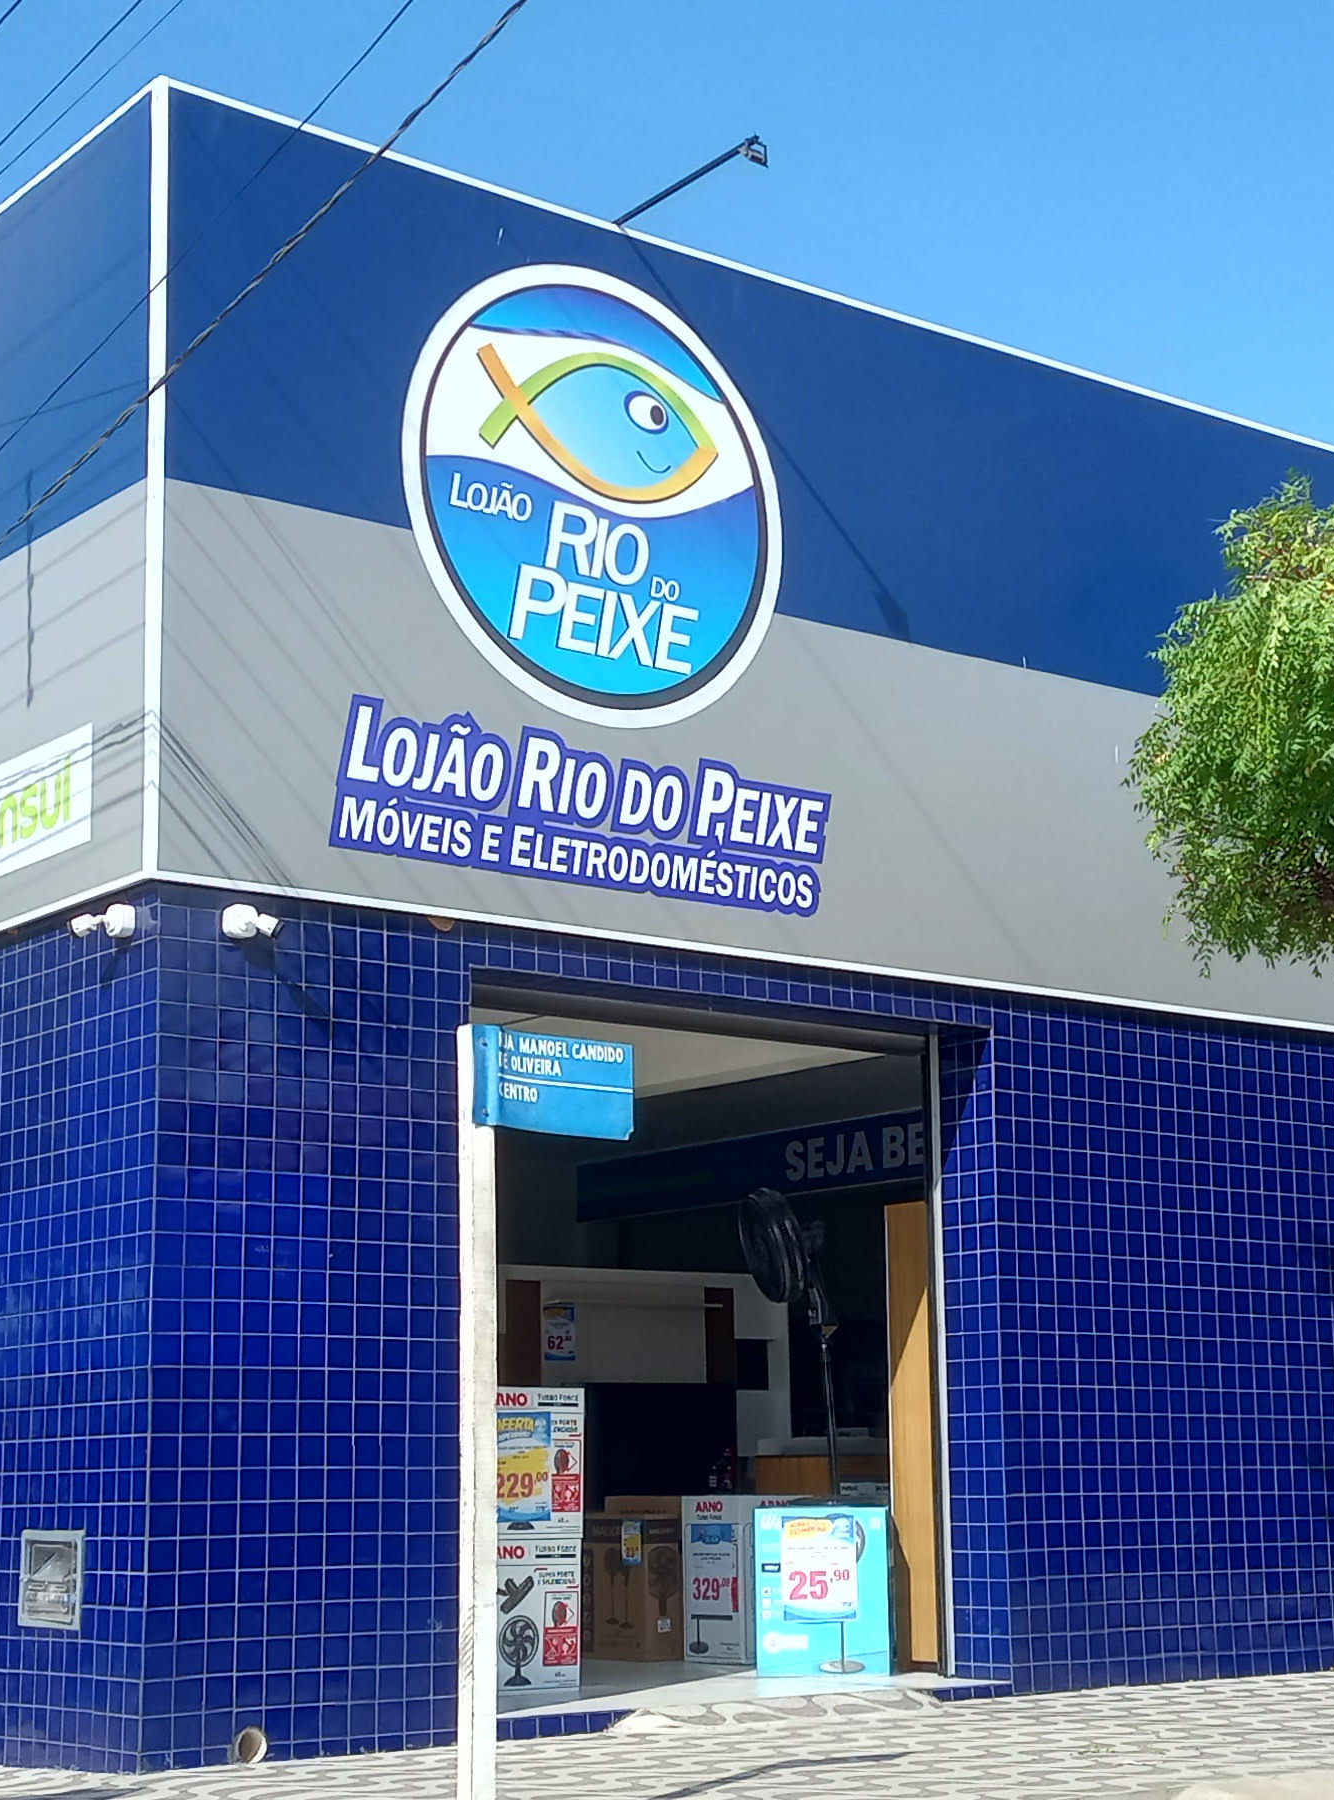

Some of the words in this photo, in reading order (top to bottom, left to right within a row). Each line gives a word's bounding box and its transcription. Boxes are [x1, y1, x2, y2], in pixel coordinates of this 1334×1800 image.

[449, 472, 533, 523] LOJÃO
[544, 501, 650, 586] RIO
[650, 575, 681, 602] DO
[507, 563, 700, 676] PEIXE
[619, 768, 685, 832] DO
[480, 825, 503, 863] E
[519, 1037, 569, 1058] MANOEL
[571, 1043, 624, 1063] CANDIDO
[511, 1057, 562, 1077] OLIVEIRA
[785, 1131, 874, 1182] SEJA
[497, 1393, 528, 1407] RNO
[695, 1500, 723, 1513] ARNO
